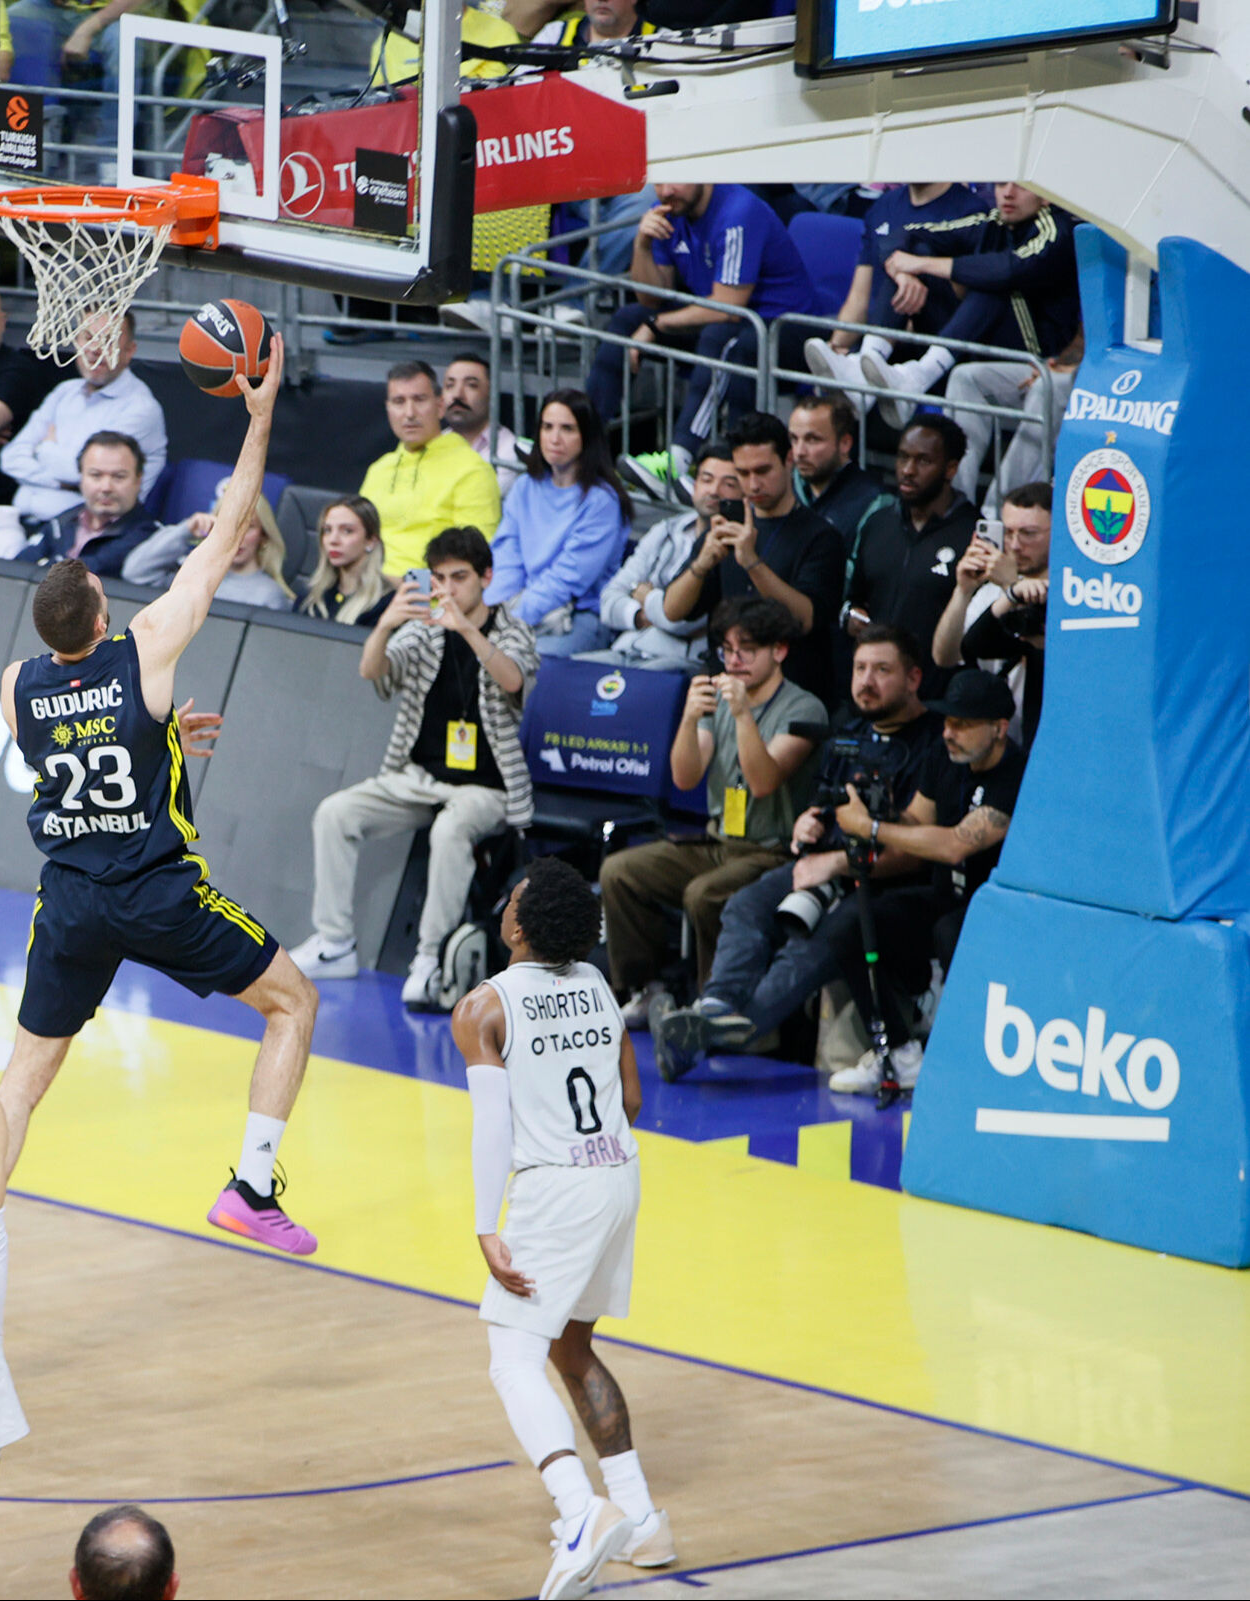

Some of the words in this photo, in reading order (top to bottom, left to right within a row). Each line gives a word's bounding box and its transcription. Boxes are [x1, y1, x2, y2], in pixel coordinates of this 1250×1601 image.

[0, 130, 37, 146] TURKISH
[0, 142, 37, 158] AIRLINES
[475, 126, 575, 169] IRLINES
[1063, 388, 1179, 435] SPALDING
[1062, 566, 1142, 615] beko
[30, 678, 123, 720] GUDURIĆ
[73, 716, 117, 739] MSC
[44, 745, 137, 810] 23
[570, 752, 614, 773] Petrol
[615, 757, 650, 776] Ofisi
[522, 989, 591, 1021] SHORTS
[531, 1026, 612, 1056] O'TACOS
[984, 981, 1180, 1110] beko
[566, 1066, 602, 1135] 0
[569, 1135, 628, 1167] PARIS
